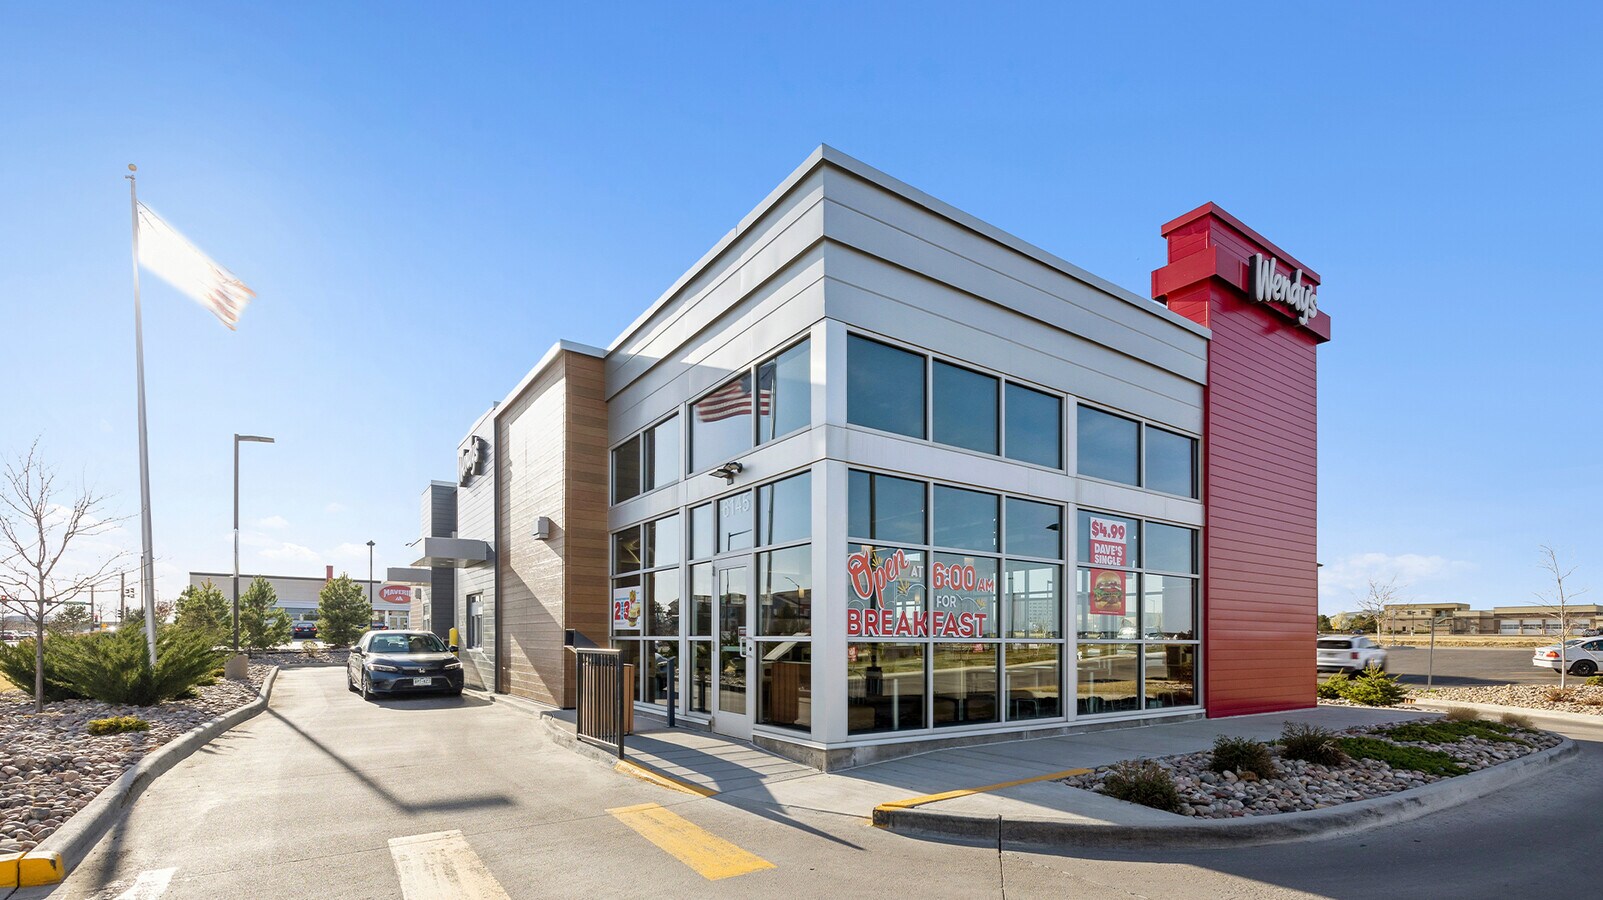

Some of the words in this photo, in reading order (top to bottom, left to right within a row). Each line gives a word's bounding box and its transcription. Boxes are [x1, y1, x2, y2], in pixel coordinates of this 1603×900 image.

[1255, 252, 1318, 325] Wendy's
[1091, 519, 1125, 540] $4.99
[1094, 542, 1123, 557] DAVE'S
[1094, 554, 1122, 566] SINGLE
[848, 549, 910, 609] Open
[911, 565, 924, 578] AT
[933, 561, 976, 592] 6:00
[977, 578, 994, 592] AM
[615, 601, 621, 620] 2
[936, 595, 957, 608] FOR
[848, 609, 987, 638] BREAKFAST
